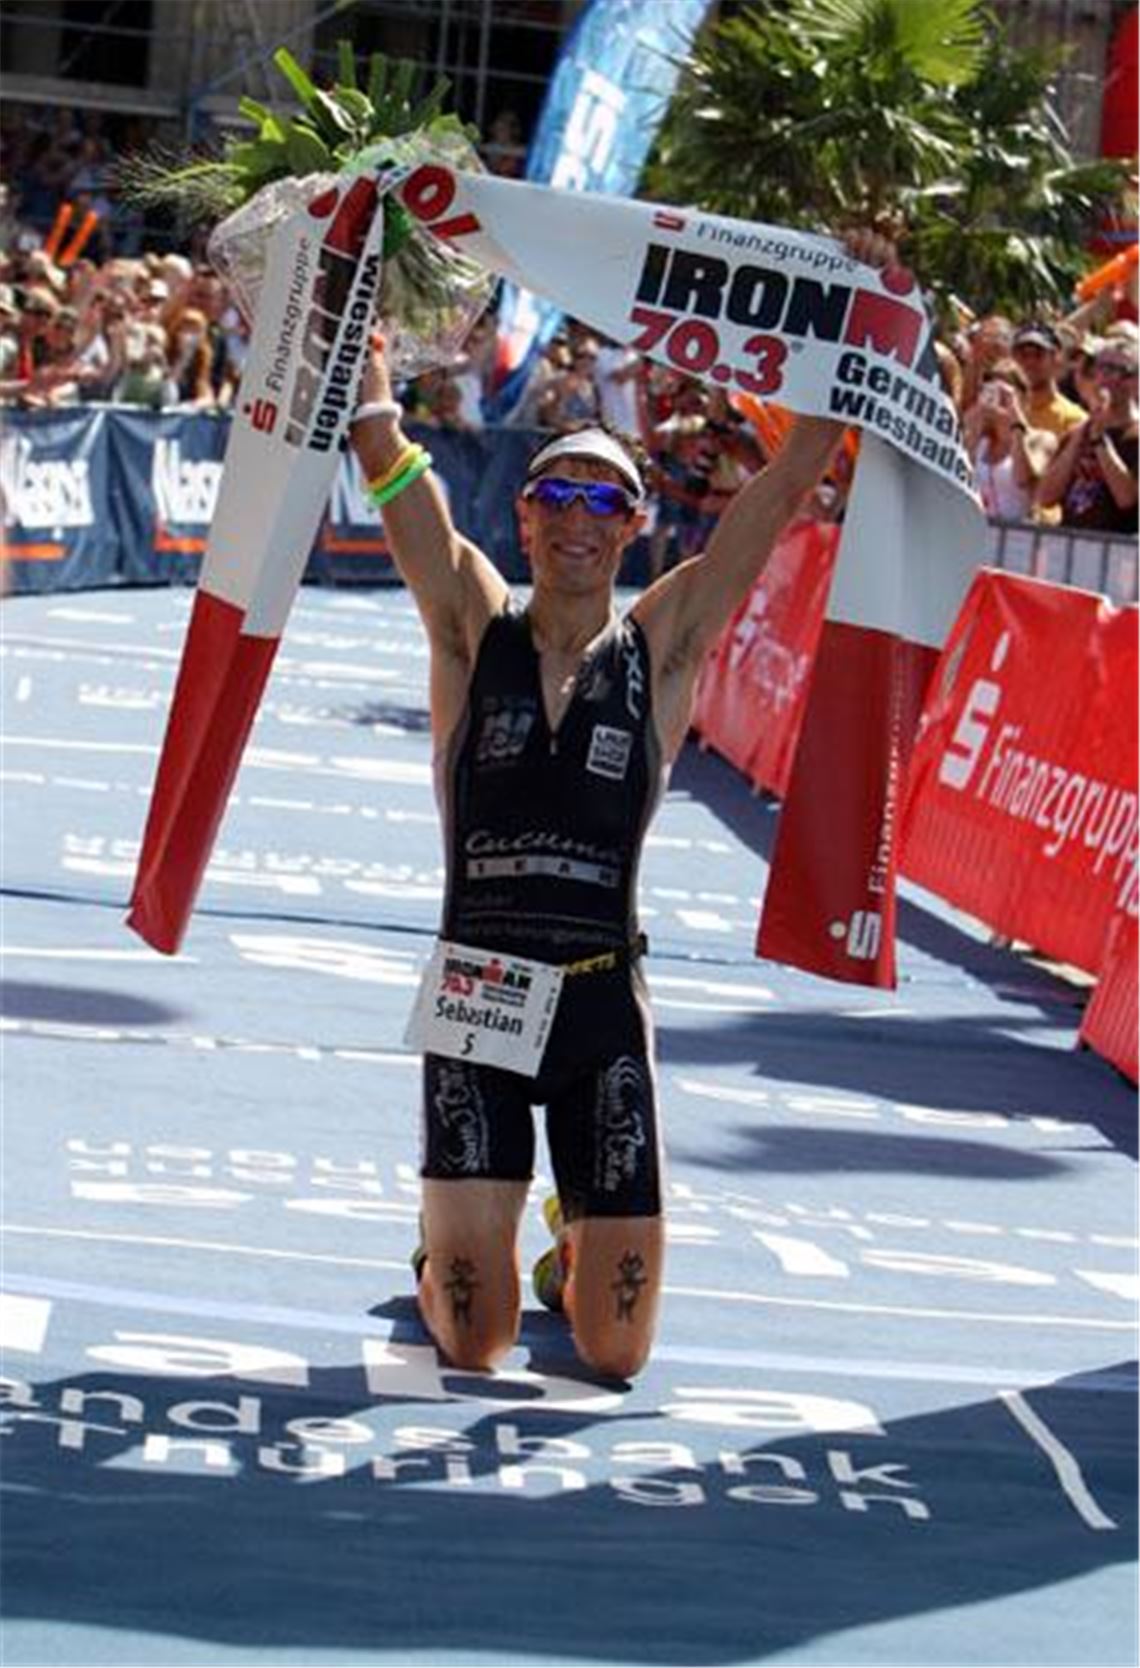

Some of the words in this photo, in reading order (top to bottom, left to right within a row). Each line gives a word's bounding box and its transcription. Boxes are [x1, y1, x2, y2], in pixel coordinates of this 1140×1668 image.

[629, 307, 788, 395] 70.3
[829, 386, 974, 490] Wiesbade
[836, 352, 961, 443] Germa
[435, 996, 523, 1035] Sebastian
[461, 1033, 476, 1055] 5
